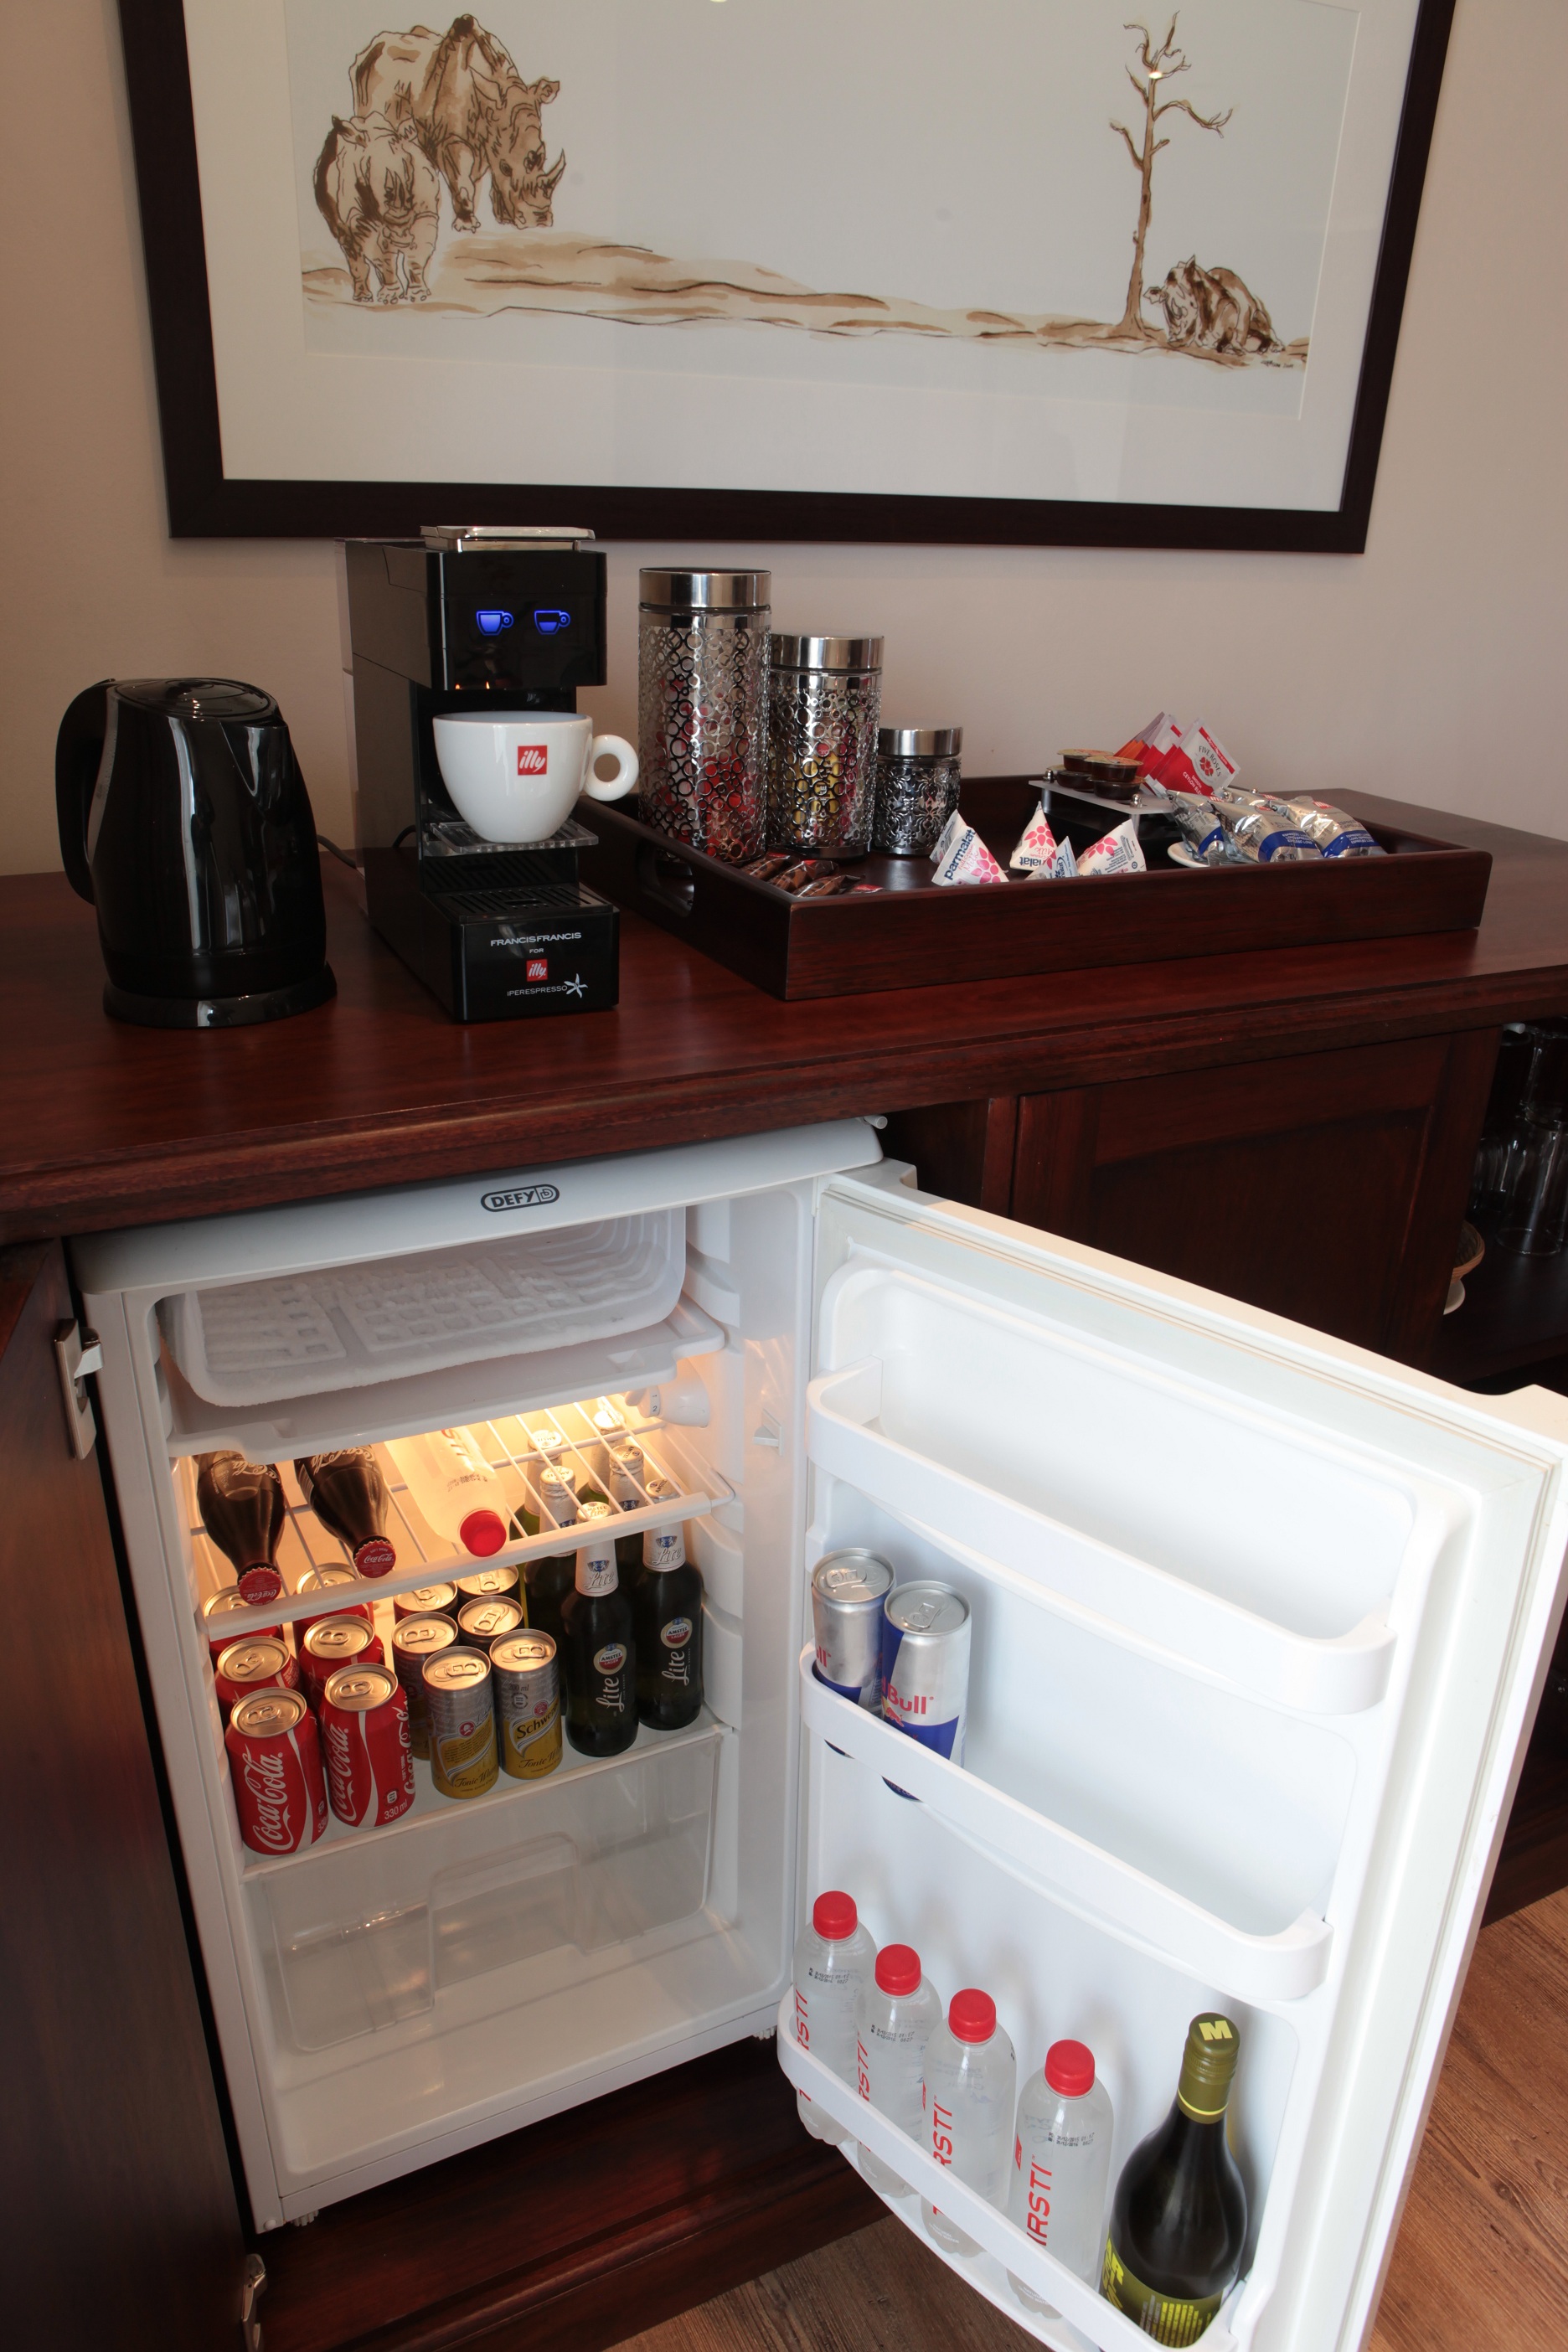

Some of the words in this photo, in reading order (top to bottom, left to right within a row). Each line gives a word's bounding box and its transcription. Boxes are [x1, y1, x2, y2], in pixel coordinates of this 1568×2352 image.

[518, 749, 546, 773] illy
[1198, 745, 1210, 756] FIVE
[1210, 753, 1222, 777] ROSES
[1183, 771, 1195, 787] CEYLON
[944, 828, 977, 880] parmalat
[963, 851, 979, 872] Milk
[490, 932, 582, 946] FRANCISFRANCIS
[528, 962, 547, 979] illy
[491, 1190, 535, 1208] DEFY
[652, 1546, 682, 1565] Lite
[585, 1571, 615, 1591] Lite
[668, 1626, 688, 1635] AMSTEL
[601, 1652, 622, 1662] AMSTEL
[661, 1650, 689, 1686] Lite
[520, 1684, 529, 1692] ml
[596, 1676, 625, 1713] Lite
[887, 1683, 927, 1715] Bull
[518, 1759, 546, 1768] Tonic
[454, 1777, 478, 1787] Tonic
[243, 1743, 294, 1851] Coca-Cola
[384, 1806, 400, 1820] 330
[400, 1798, 409, 1813] ml
[1199, 2019, 1233, 2041] M
[1026, 2161, 1052, 2246] IRSTI
